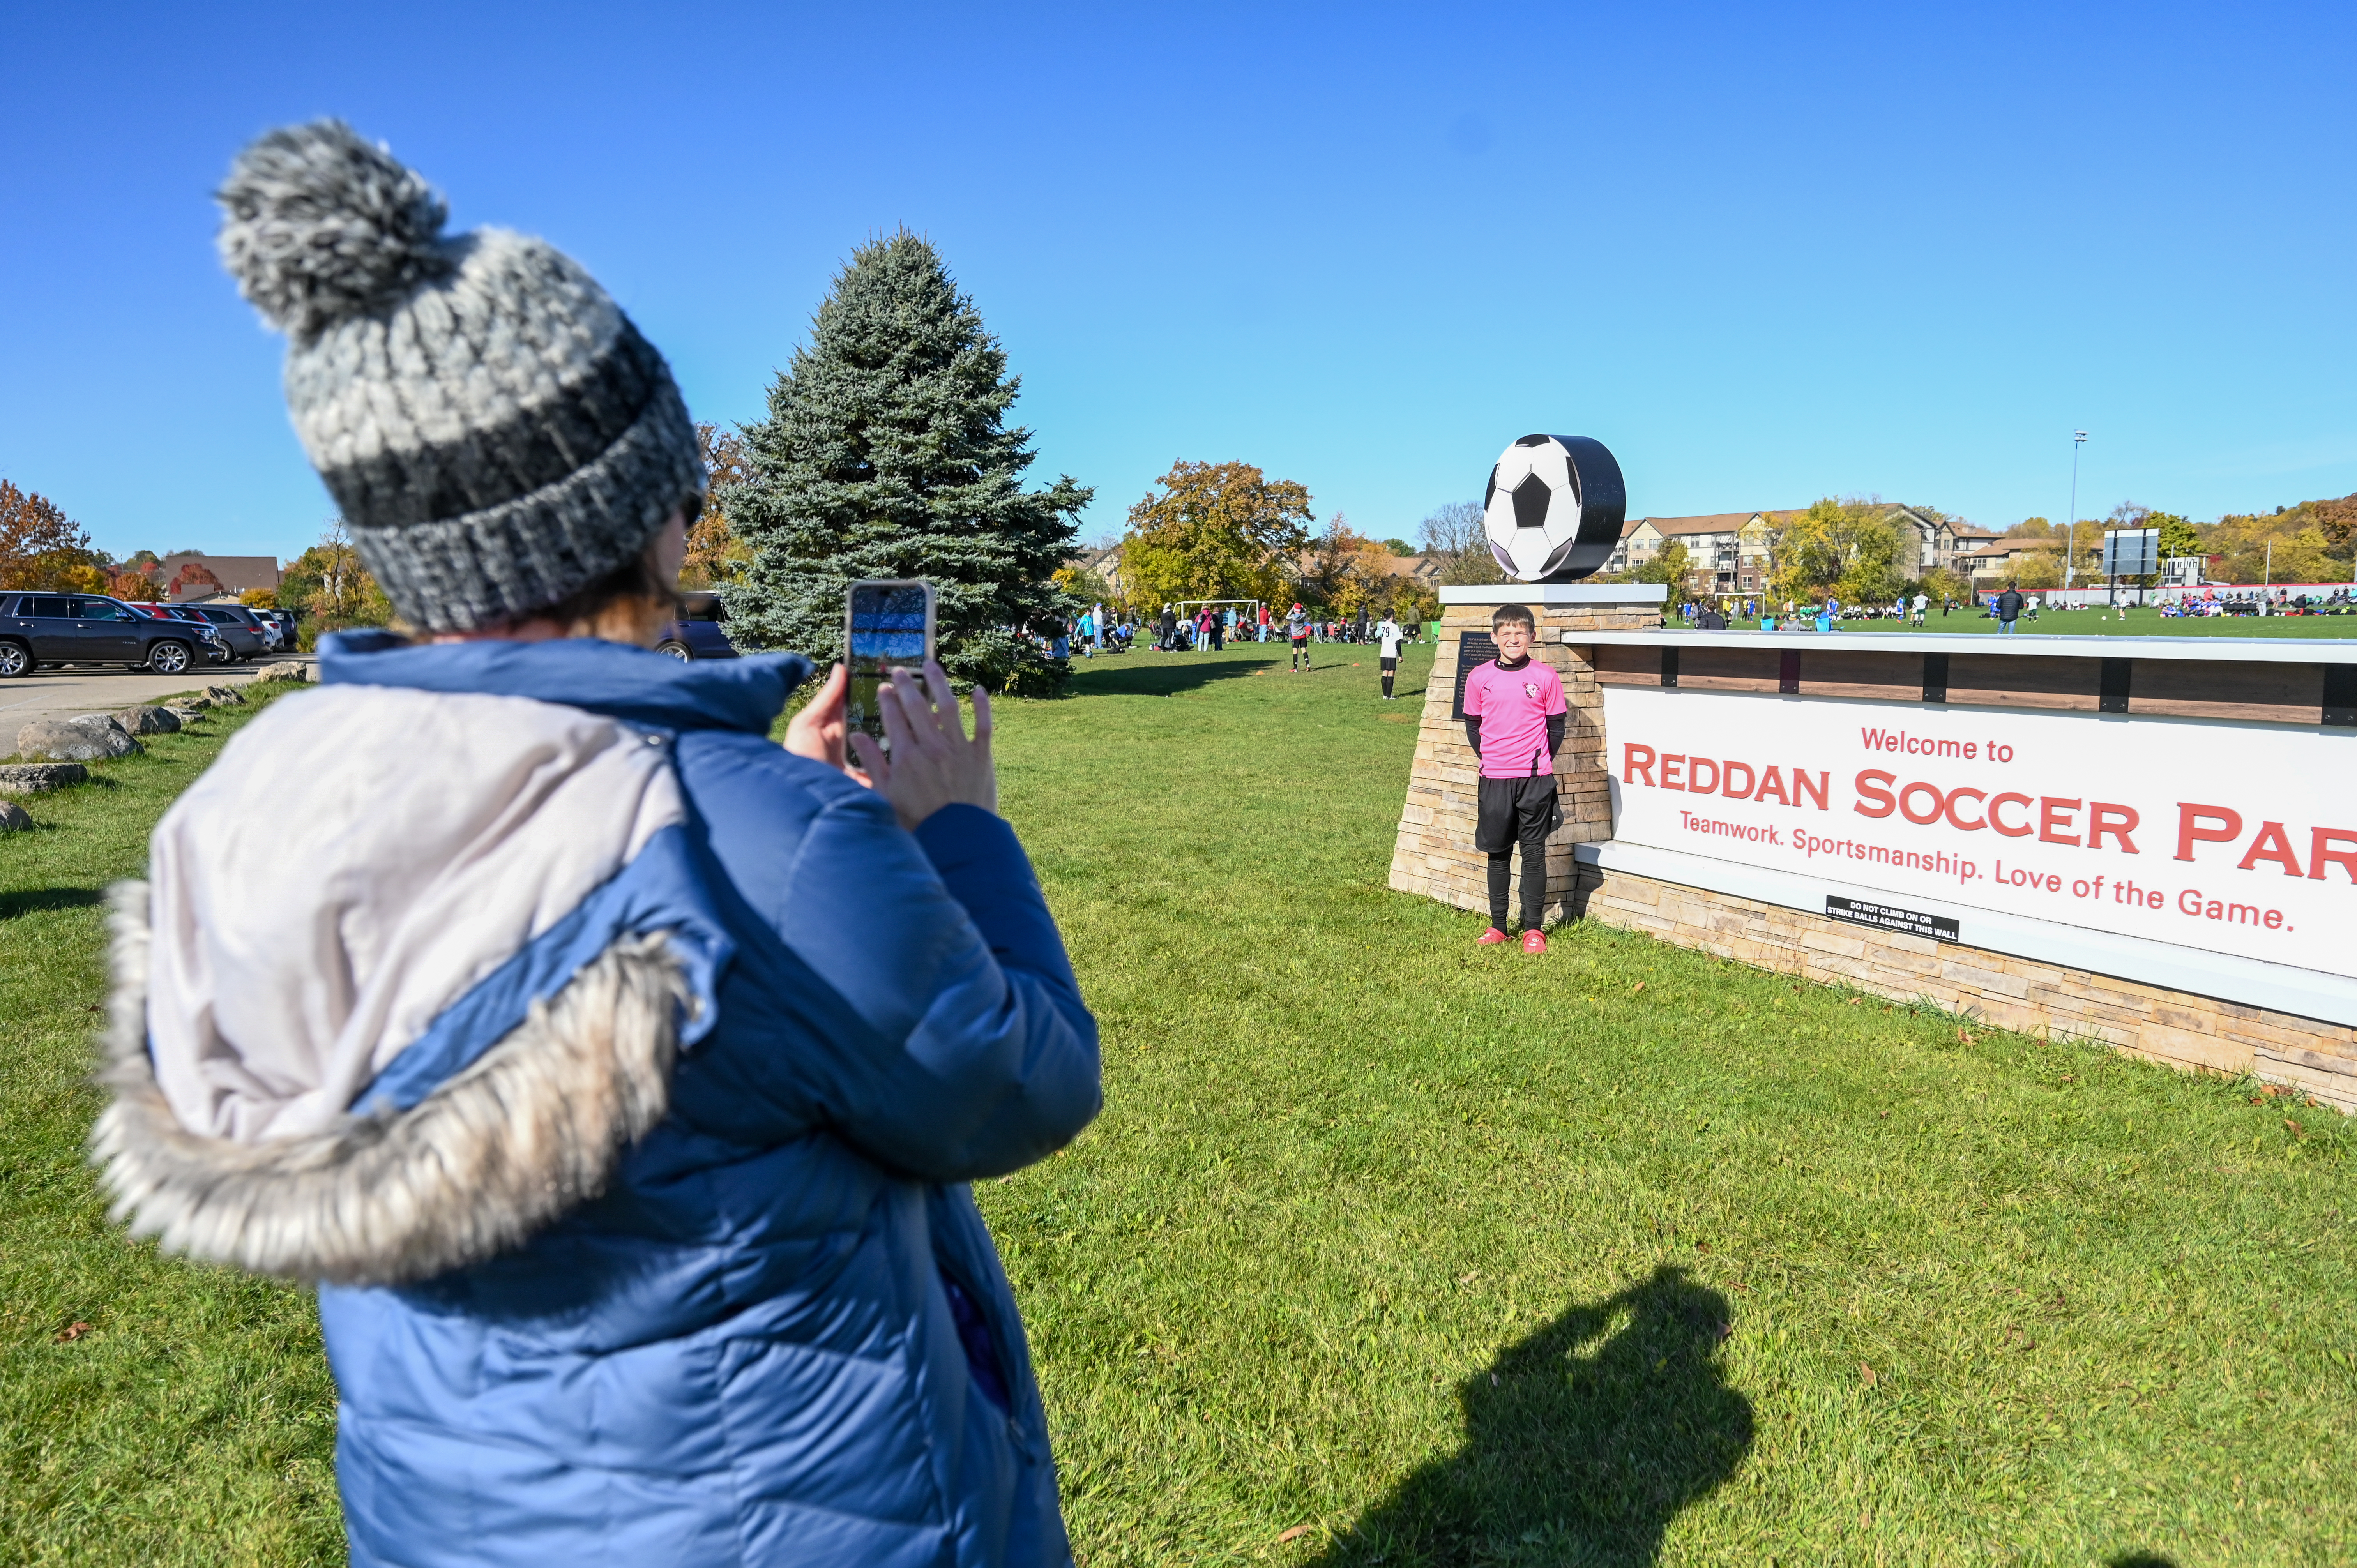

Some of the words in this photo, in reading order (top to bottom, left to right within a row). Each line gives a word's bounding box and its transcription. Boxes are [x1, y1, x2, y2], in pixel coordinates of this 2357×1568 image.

[1382, 627, 1390, 637] 79
[1862, 727, 1977, 759] Welcome
[1987, 740, 2013, 762] to
[1624, 743, 1830, 810] REDDAN
[1854, 769, 2140, 854] SOCCER
[1680, 810, 1785, 846] Teamwork.
[1793, 828, 1983, 885] Sportsmanship.
[1996, 860, 2062, 892] Love
[2072, 875, 2104, 899] of
[2113, 880, 2164, 909] the
[2178, 889, 2294, 932] Game.
[1827, 906, 1853, 918] STRIKE
[1854, 912, 1878, 923] BALLS
[1879, 917, 1913, 930] AGAINST
[1914, 924, 1933, 934] THIS
[1934, 928, 1957, 940] WALL
[1850, 902, 1862, 910] DO
[1863, 904, 1879, 913] NOT
[1880, 908, 1905, 919] CLIMB
[1906, 913, 1918, 922] ON
[1919, 915, 1932, 924] OR
